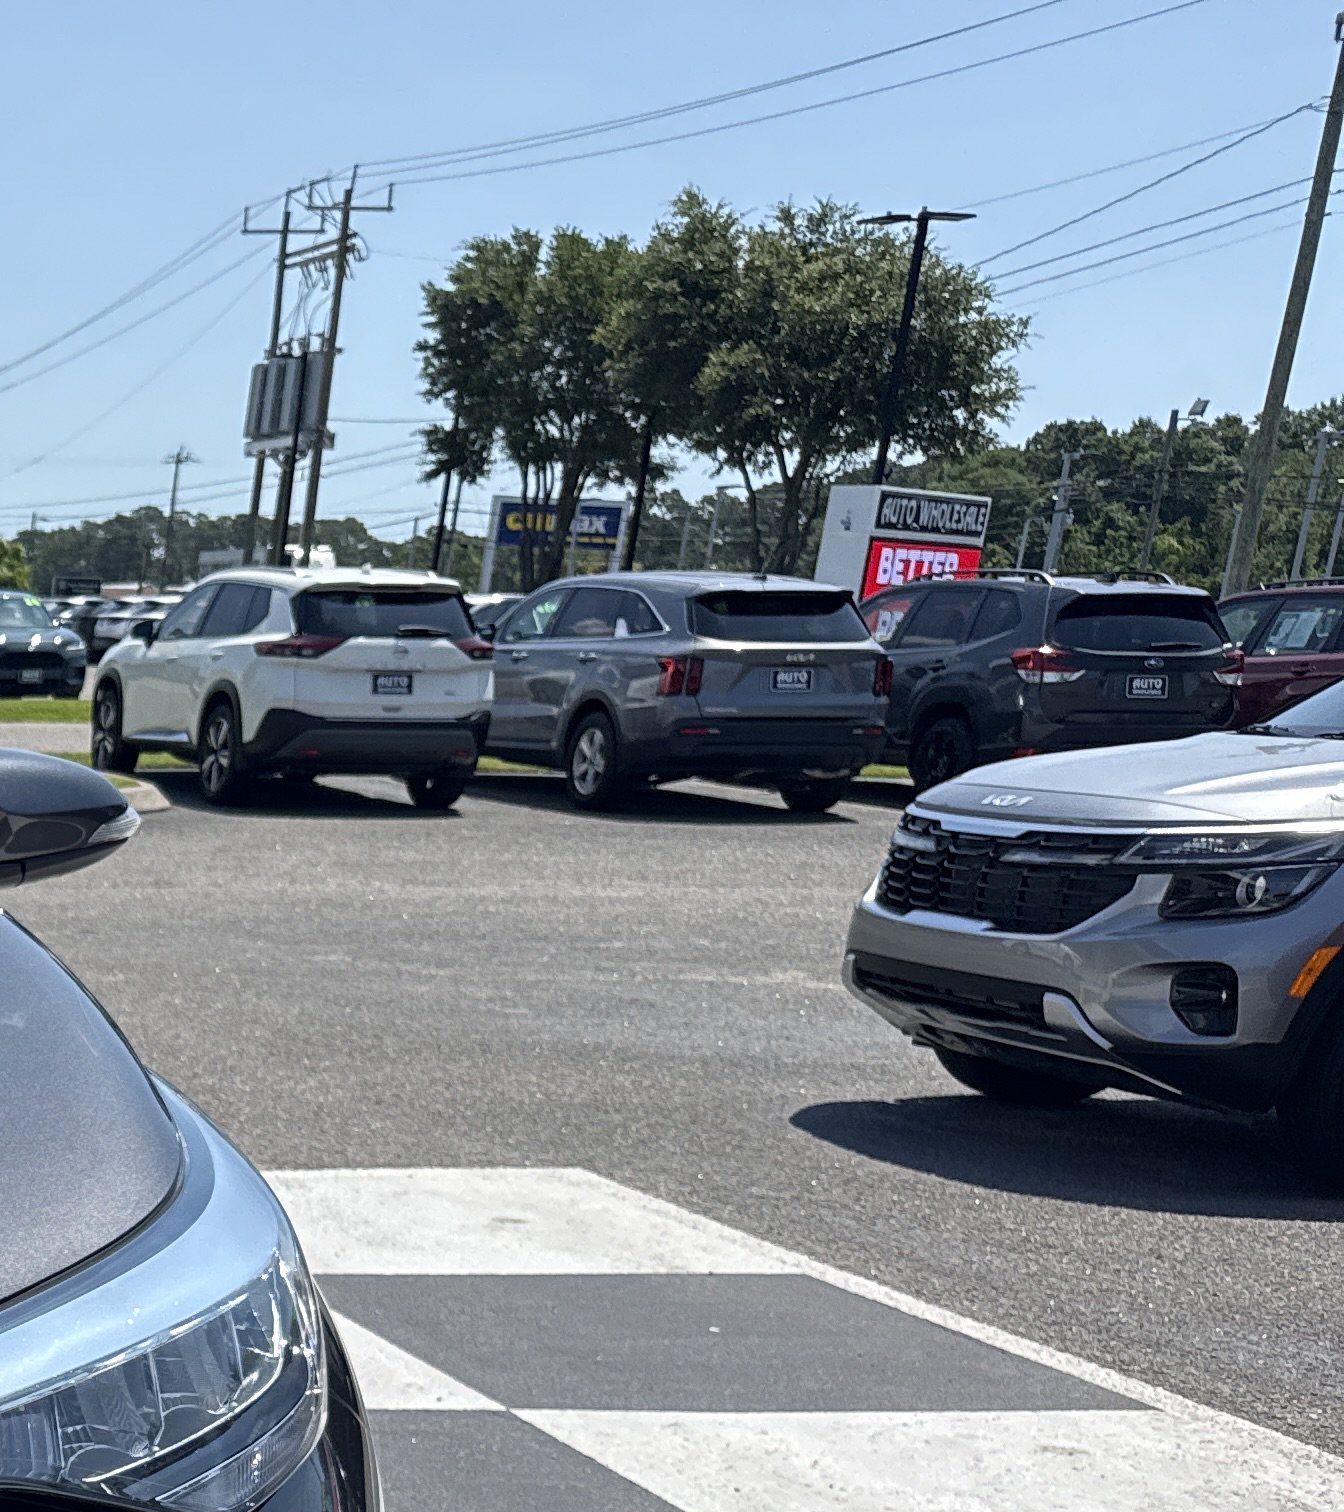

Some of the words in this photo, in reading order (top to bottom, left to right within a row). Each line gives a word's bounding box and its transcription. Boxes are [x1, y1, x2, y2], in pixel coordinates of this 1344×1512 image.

[880, 497, 917, 525] AUTO
[918, 500, 987, 533] WHOLESALE
[876, 546, 960, 586] BETTER
[376, 675, 409, 688] AUTO
[776, 670, 808, 683] AUTO
[1132, 678, 1163, 689] AUTO
